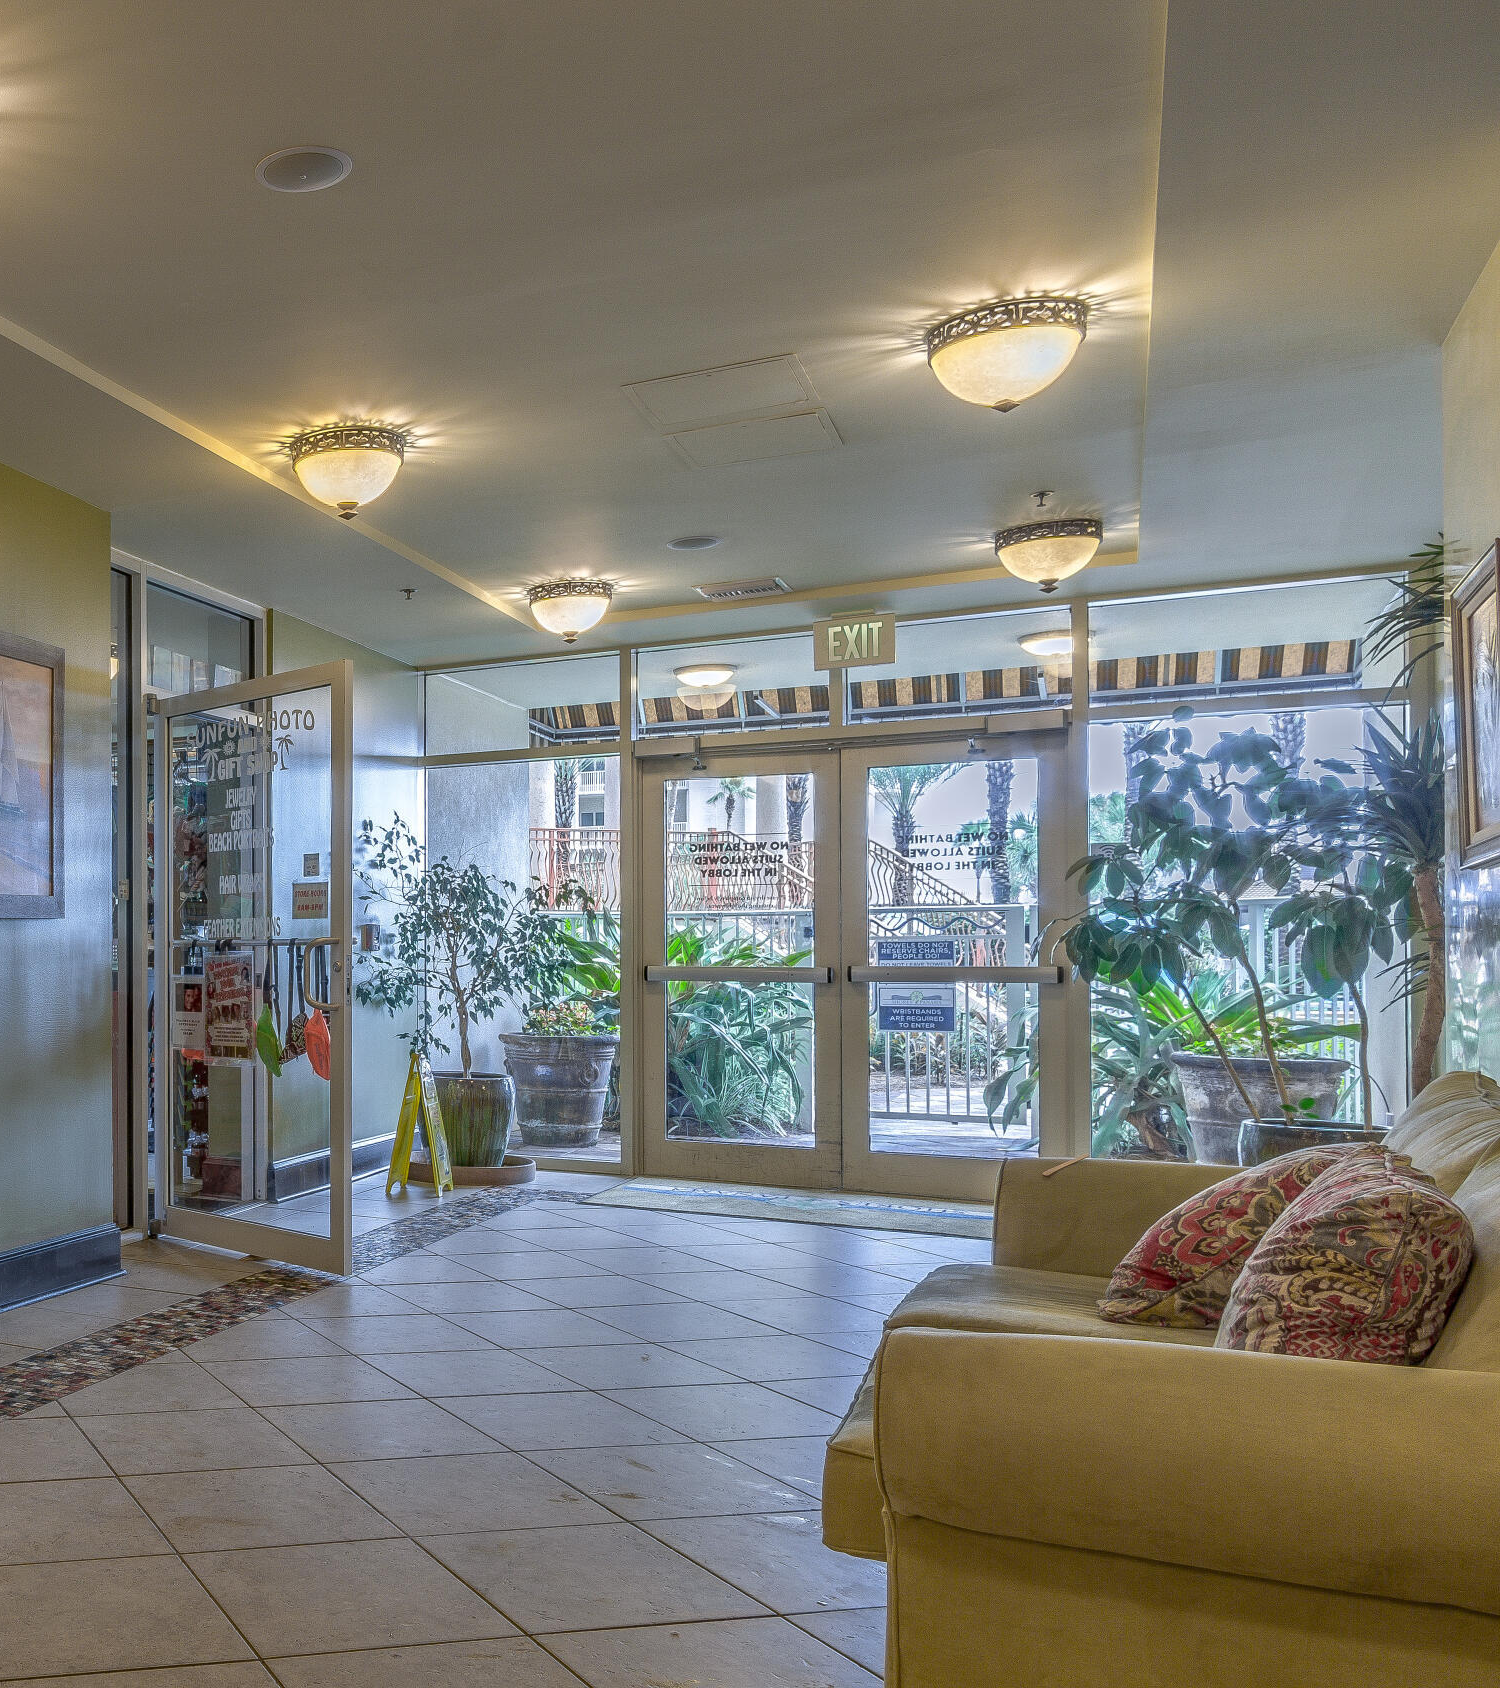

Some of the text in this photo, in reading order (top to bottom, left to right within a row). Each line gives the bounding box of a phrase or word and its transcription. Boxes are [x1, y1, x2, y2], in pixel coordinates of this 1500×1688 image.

[828, 622, 883, 662] EXIT
[256, 709, 315, 733] PHOTO
[218, 757, 243, 780] GIFT
[209, 831, 232, 852] BEACH
[220, 874, 237, 895] HAIR
[203, 919, 234, 939] FEATHER
[918, 947, 951, 955] CHAIRS,
